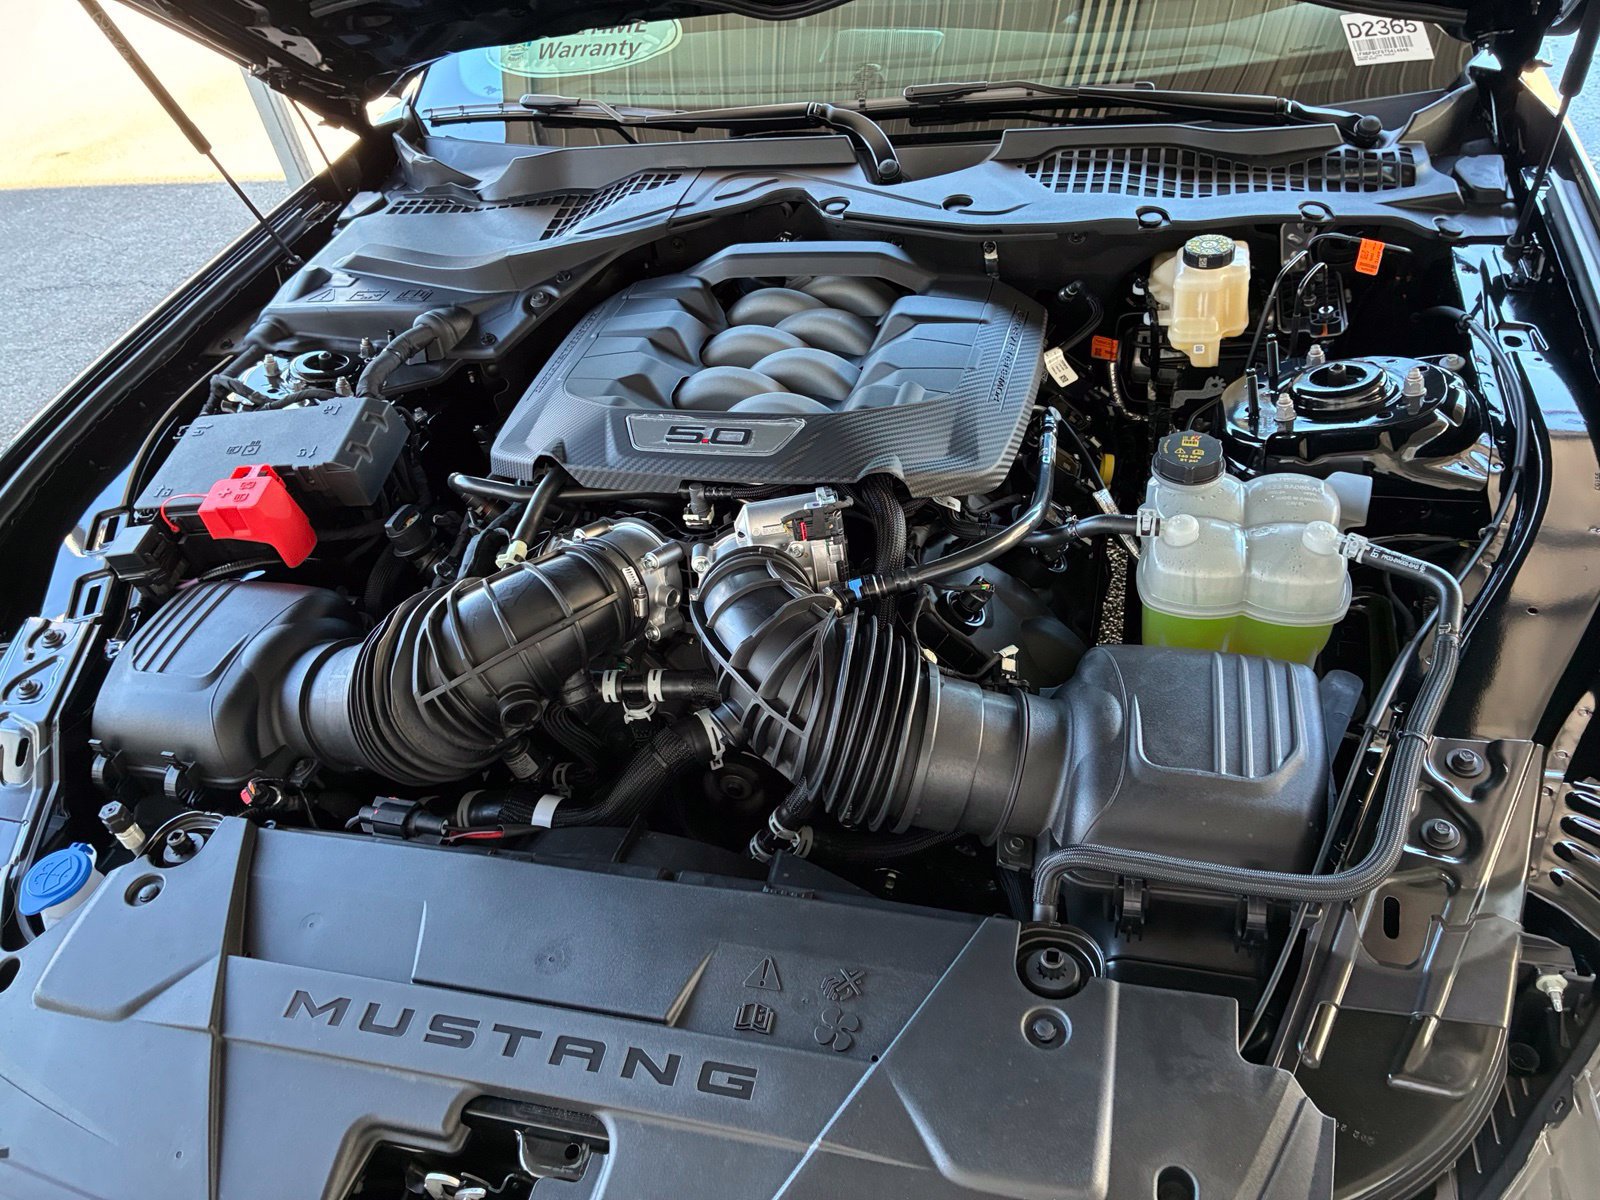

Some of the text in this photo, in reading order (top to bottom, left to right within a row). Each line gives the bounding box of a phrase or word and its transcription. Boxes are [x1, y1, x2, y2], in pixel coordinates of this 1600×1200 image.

[1347, 20, 1417, 38] D2365
[538, 40, 642, 60] Warranty
[665, 425, 753, 446] 5.0
[283, 989, 759, 1100] MUSTANG
